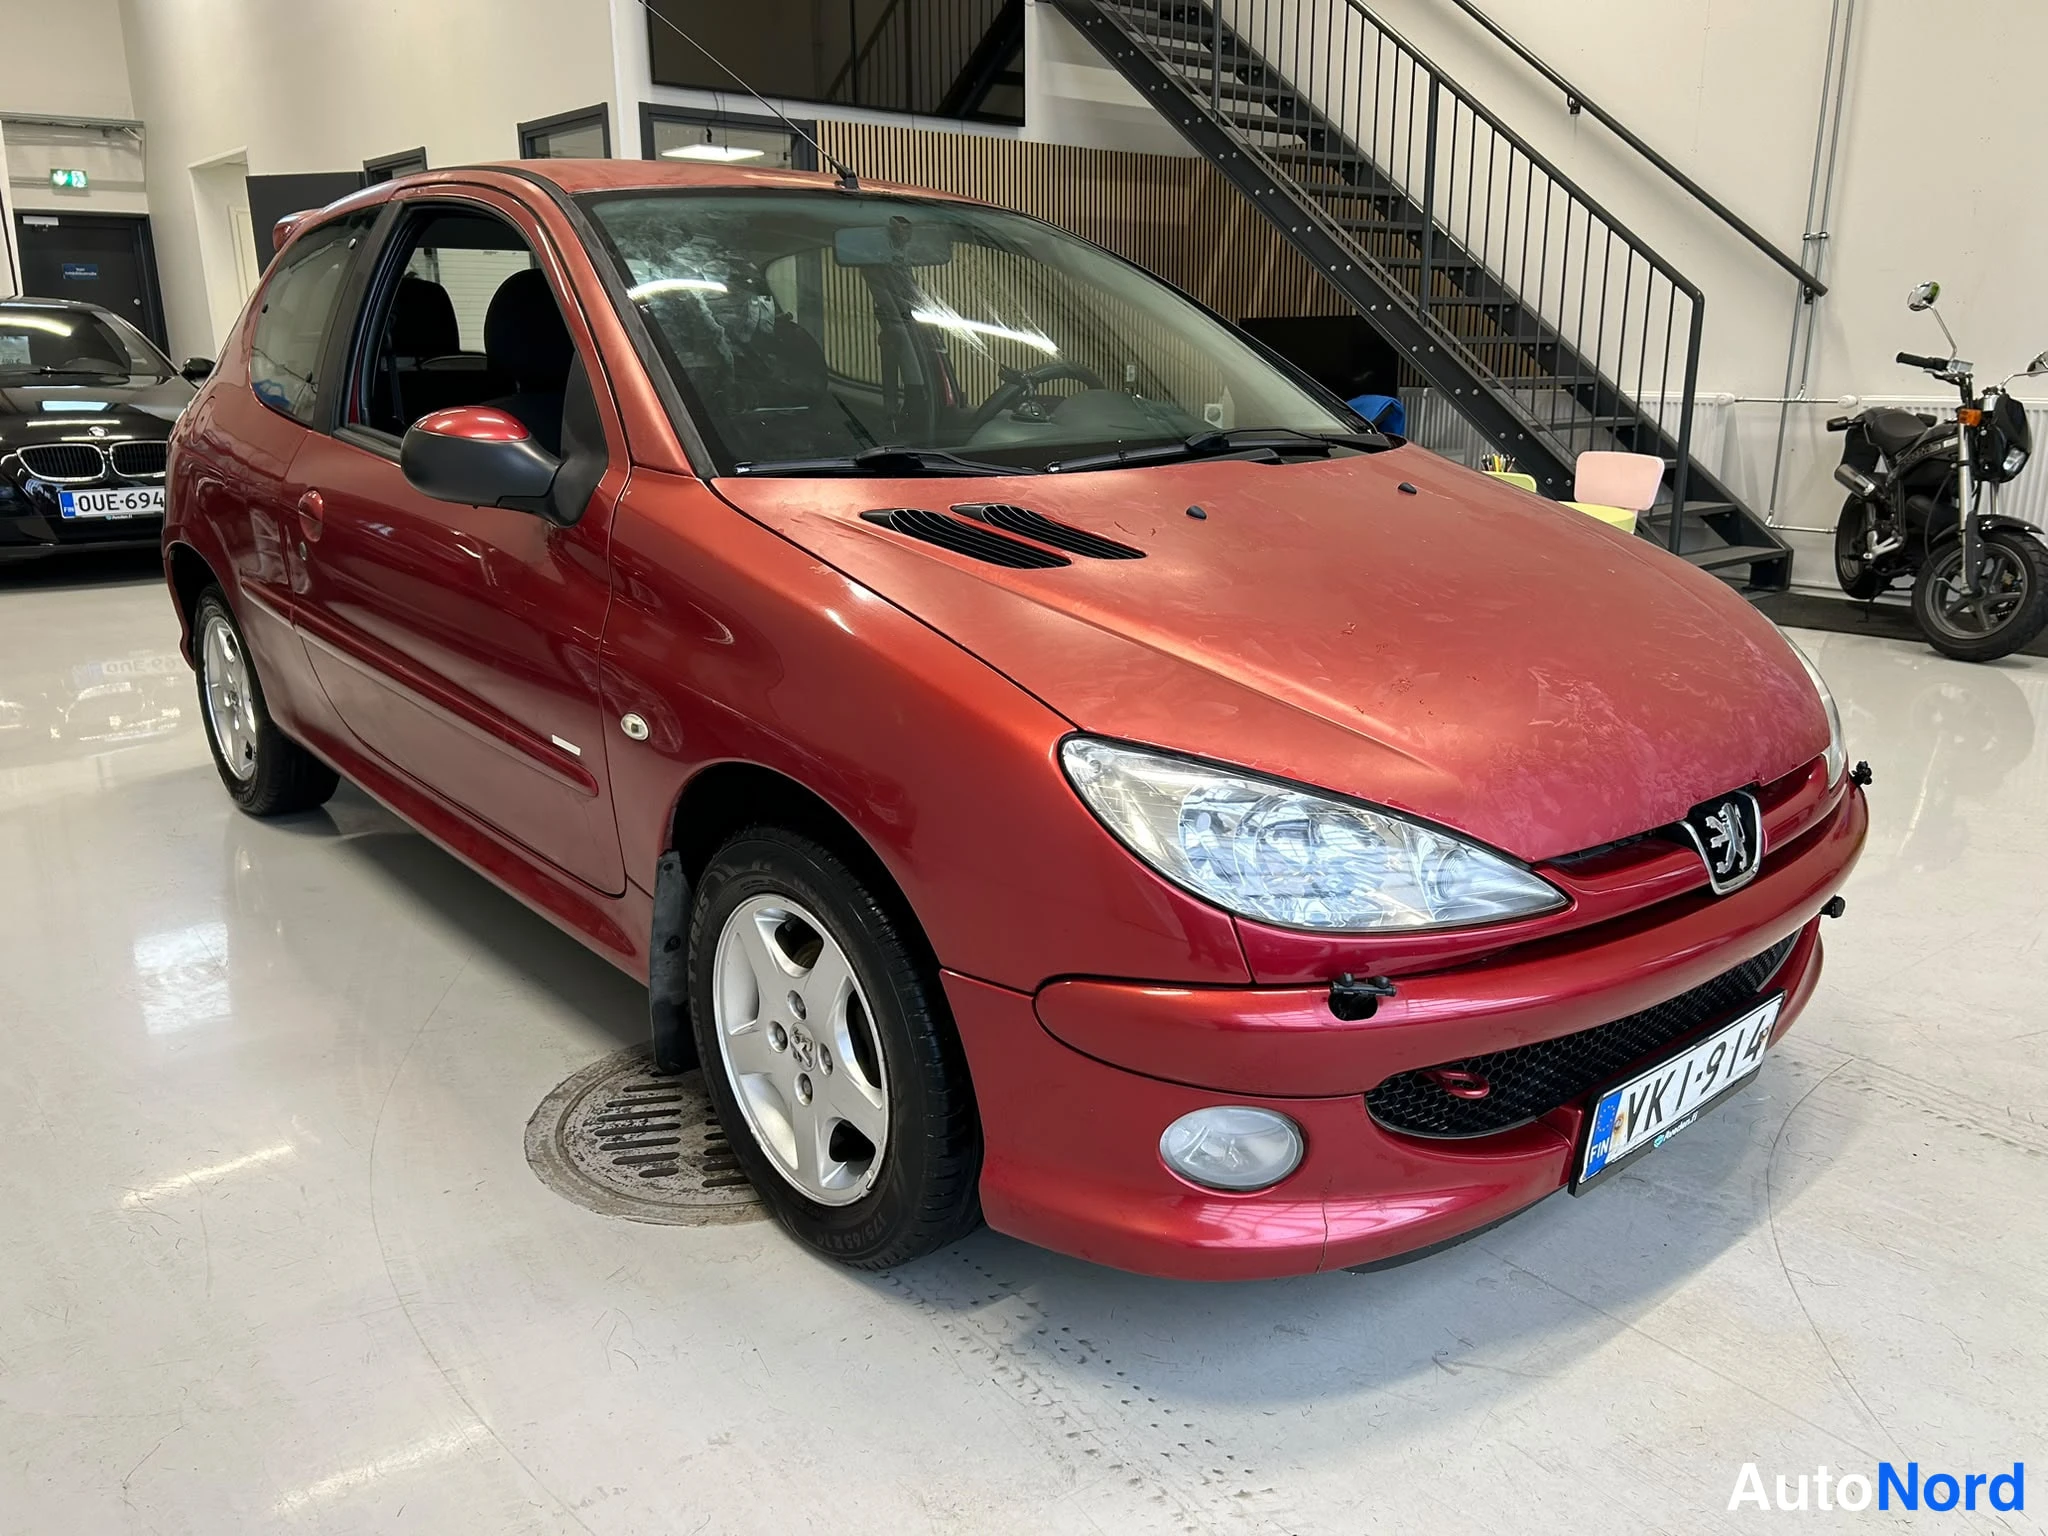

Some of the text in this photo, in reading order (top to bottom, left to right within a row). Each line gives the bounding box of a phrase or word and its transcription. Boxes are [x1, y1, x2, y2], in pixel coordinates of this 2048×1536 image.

[78, 491, 164, 513] OUE-694
[1626, 1014, 1767, 1144] VKI-914
[1589, 1136, 1610, 1164] FIN
